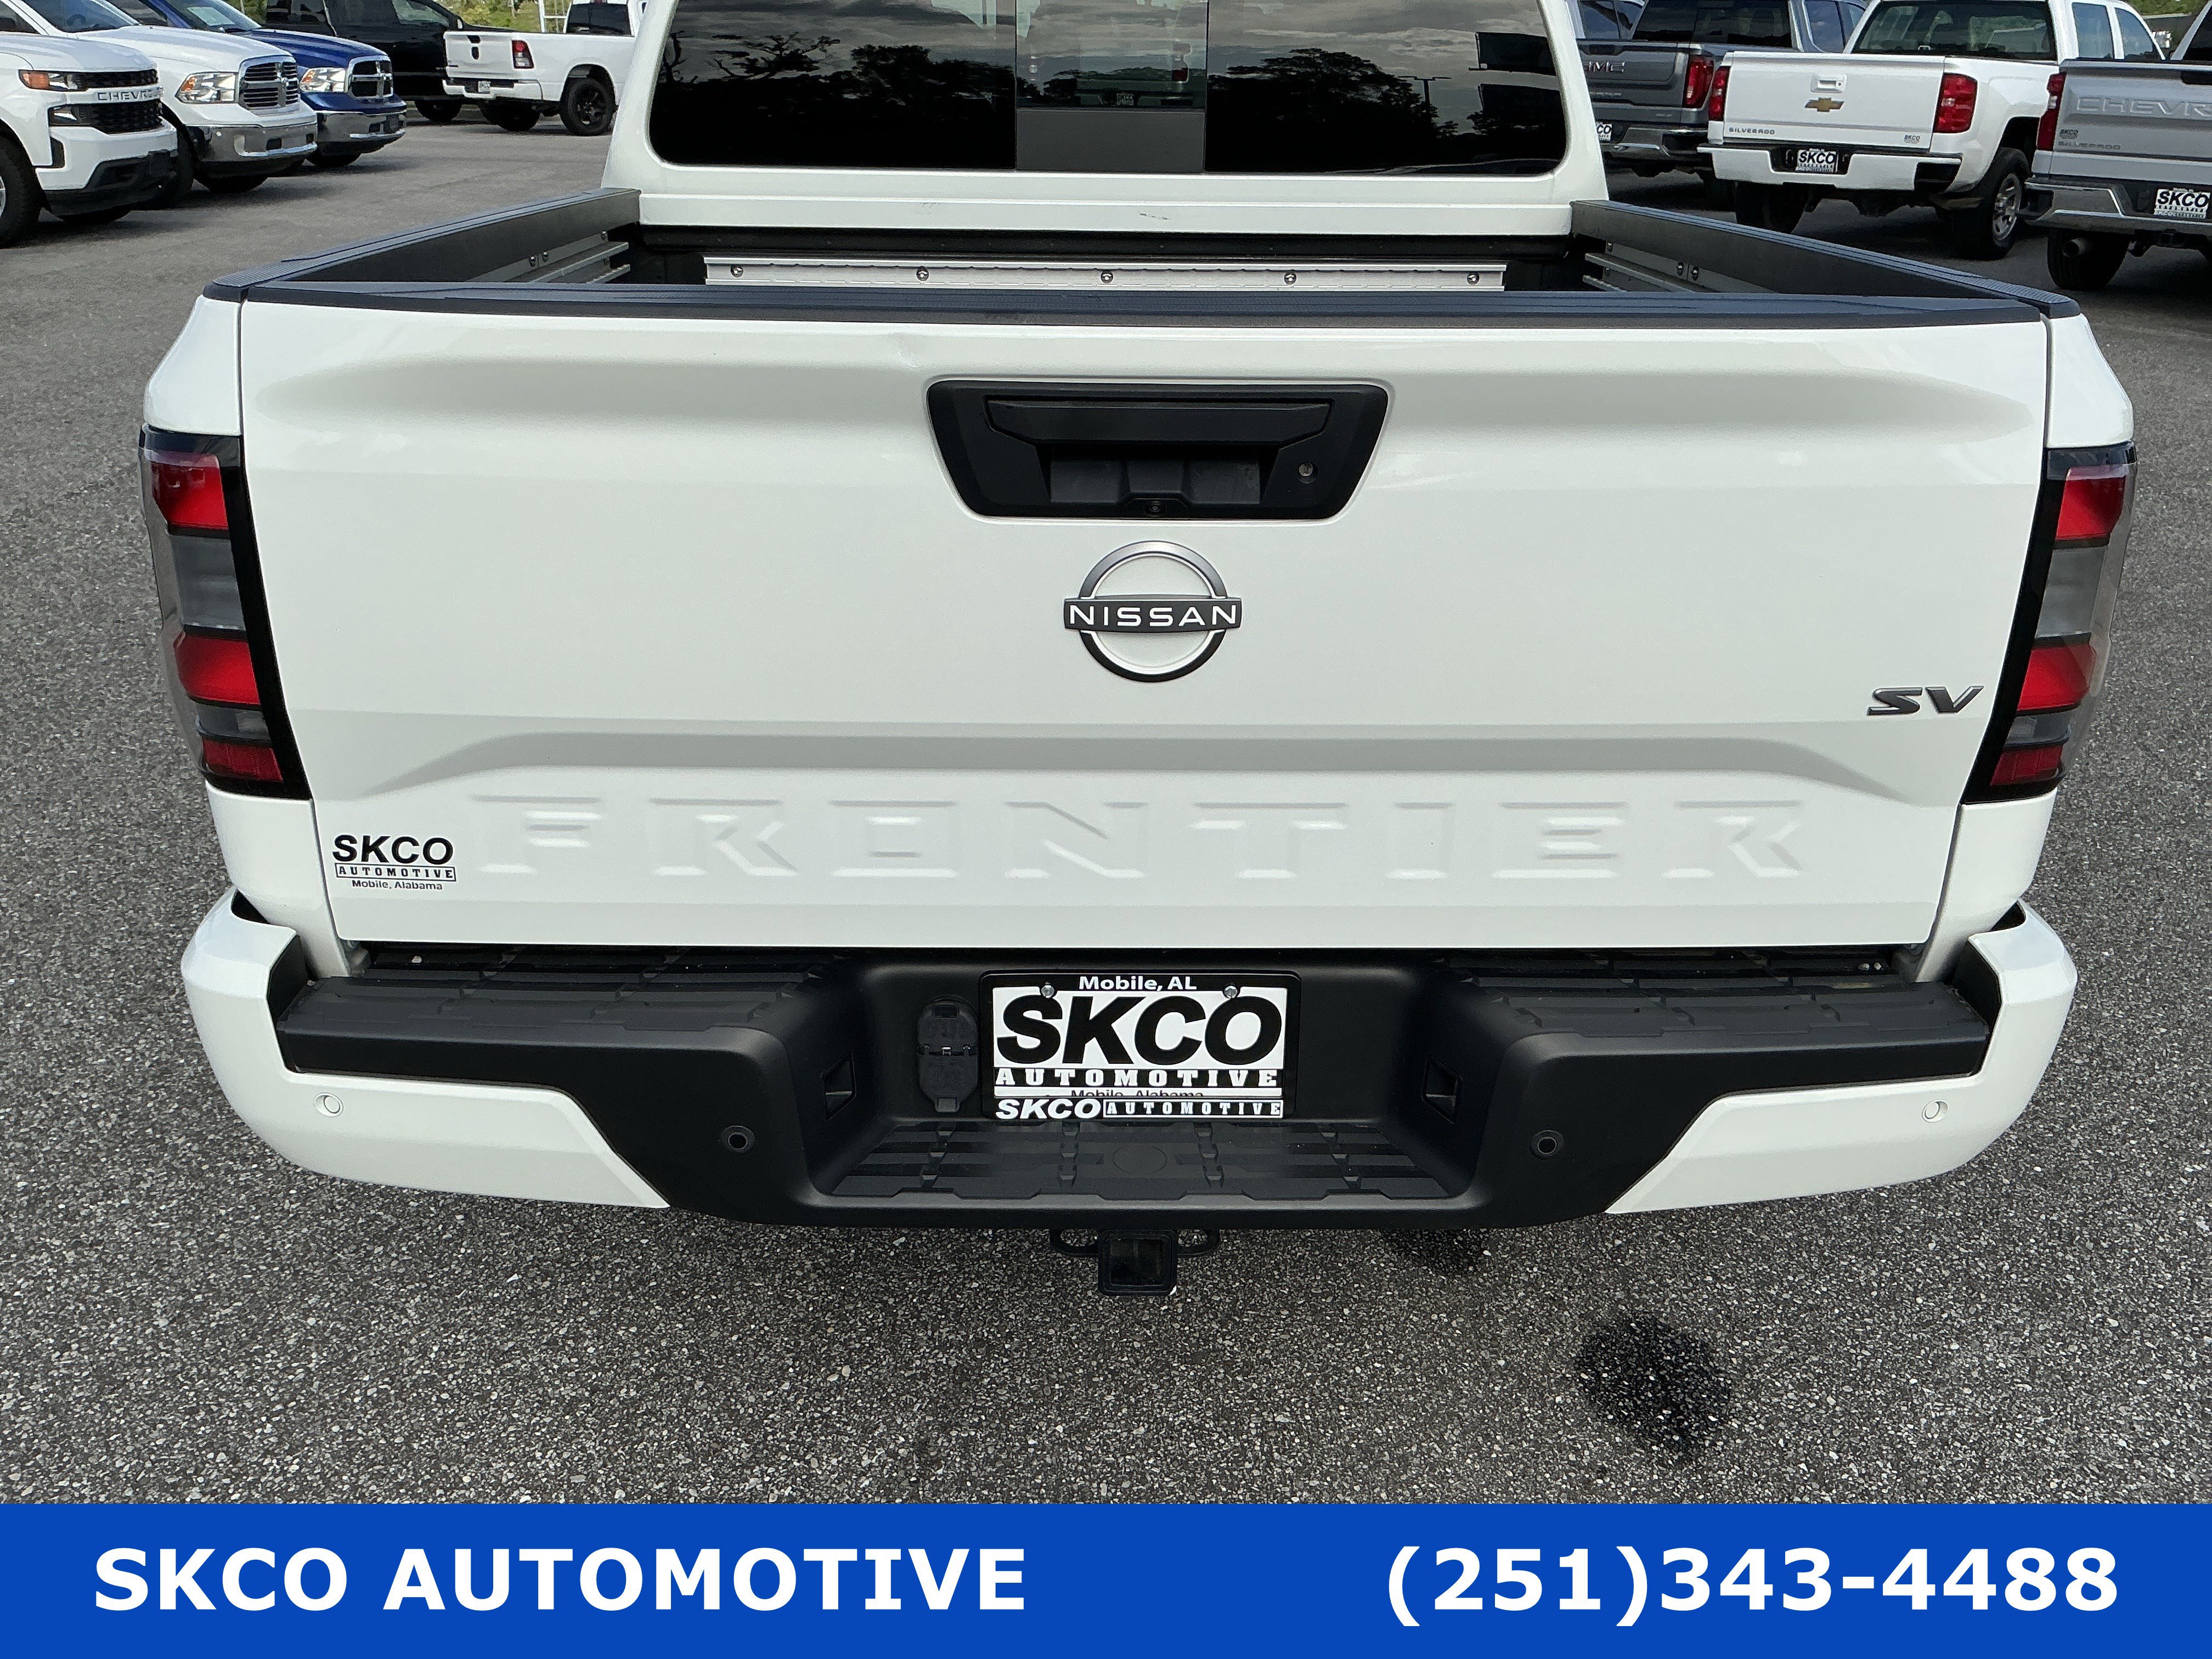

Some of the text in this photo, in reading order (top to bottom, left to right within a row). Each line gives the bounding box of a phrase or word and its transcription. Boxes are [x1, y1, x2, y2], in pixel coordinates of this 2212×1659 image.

[1597, 124, 1612, 134] CO
[1729, 127, 1775, 135] SILVERADO
[1799, 151, 1836, 164] SKCO
[2158, 191, 2208, 208] SKCO
[1069, 604, 1237, 627] NISSAN
[1867, 686, 1984, 716] SV
[472, 794, 1803, 879] FRONTIER
[332, 834, 453, 865] SKCO
[338, 866, 453, 878] AUTOMOTIVE
[352, 879, 443, 890] Mobile, Alabama
[1079, 975, 1197, 992] Mobile, AL
[996, 994, 1282, 1065] SKCO
[995, 1069, 1277, 1087] AUTOMOTIVE
[996, 1099, 1102, 1119] SKCO
[1107, 1102, 1280, 1115] AUTOMOTIVE
